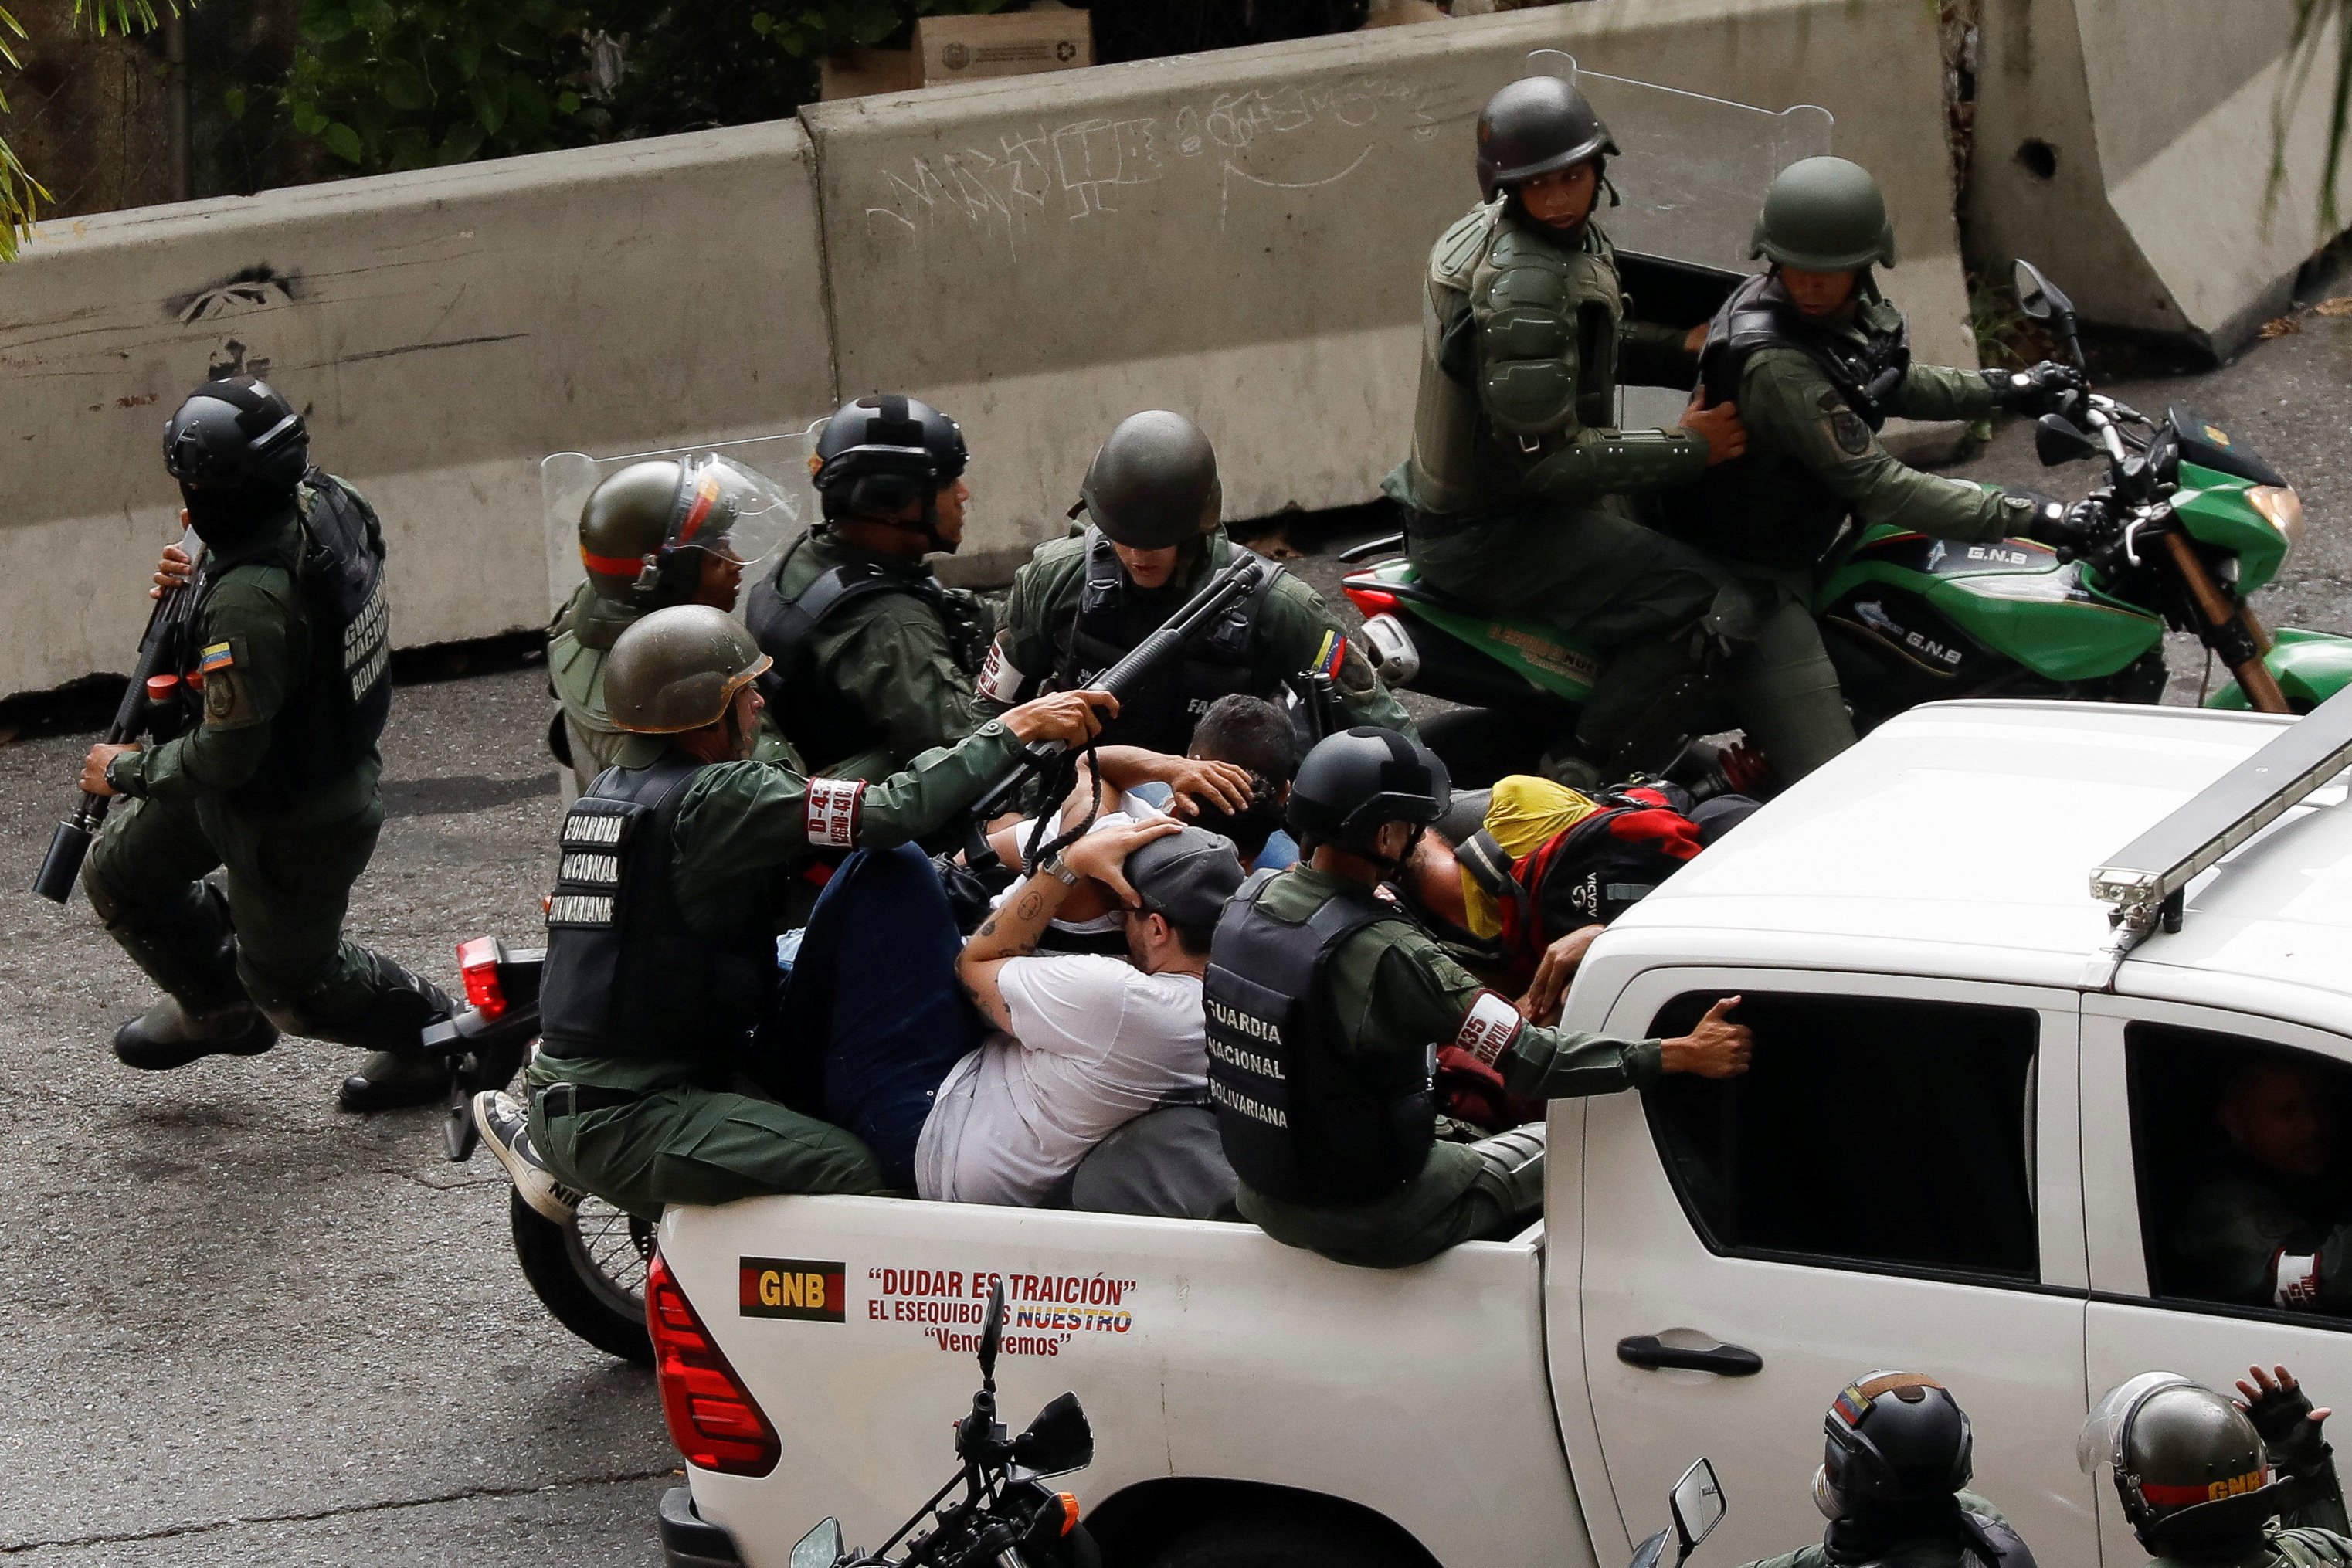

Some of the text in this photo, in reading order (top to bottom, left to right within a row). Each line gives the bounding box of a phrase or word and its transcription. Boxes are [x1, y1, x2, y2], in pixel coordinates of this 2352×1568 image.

[564, 816, 624, 843] GUARDIA
[1208, 1036, 1286, 1080] NACIONAL
[1210, 1078, 1288, 1128] BOLIVARIANA
[545, 1180, 581, 1208] NIK
[759, 1270, 825, 1308] GNB
[869, 1268, 963, 1298] “DUDAR
[1010, 1272, 1136, 1305] TRAICIÓN”
[869, 1300, 889, 1321] EL
[895, 1301, 983, 1325] ESEQUIBO
[1016, 1305, 1132, 1333] NUESTRO
